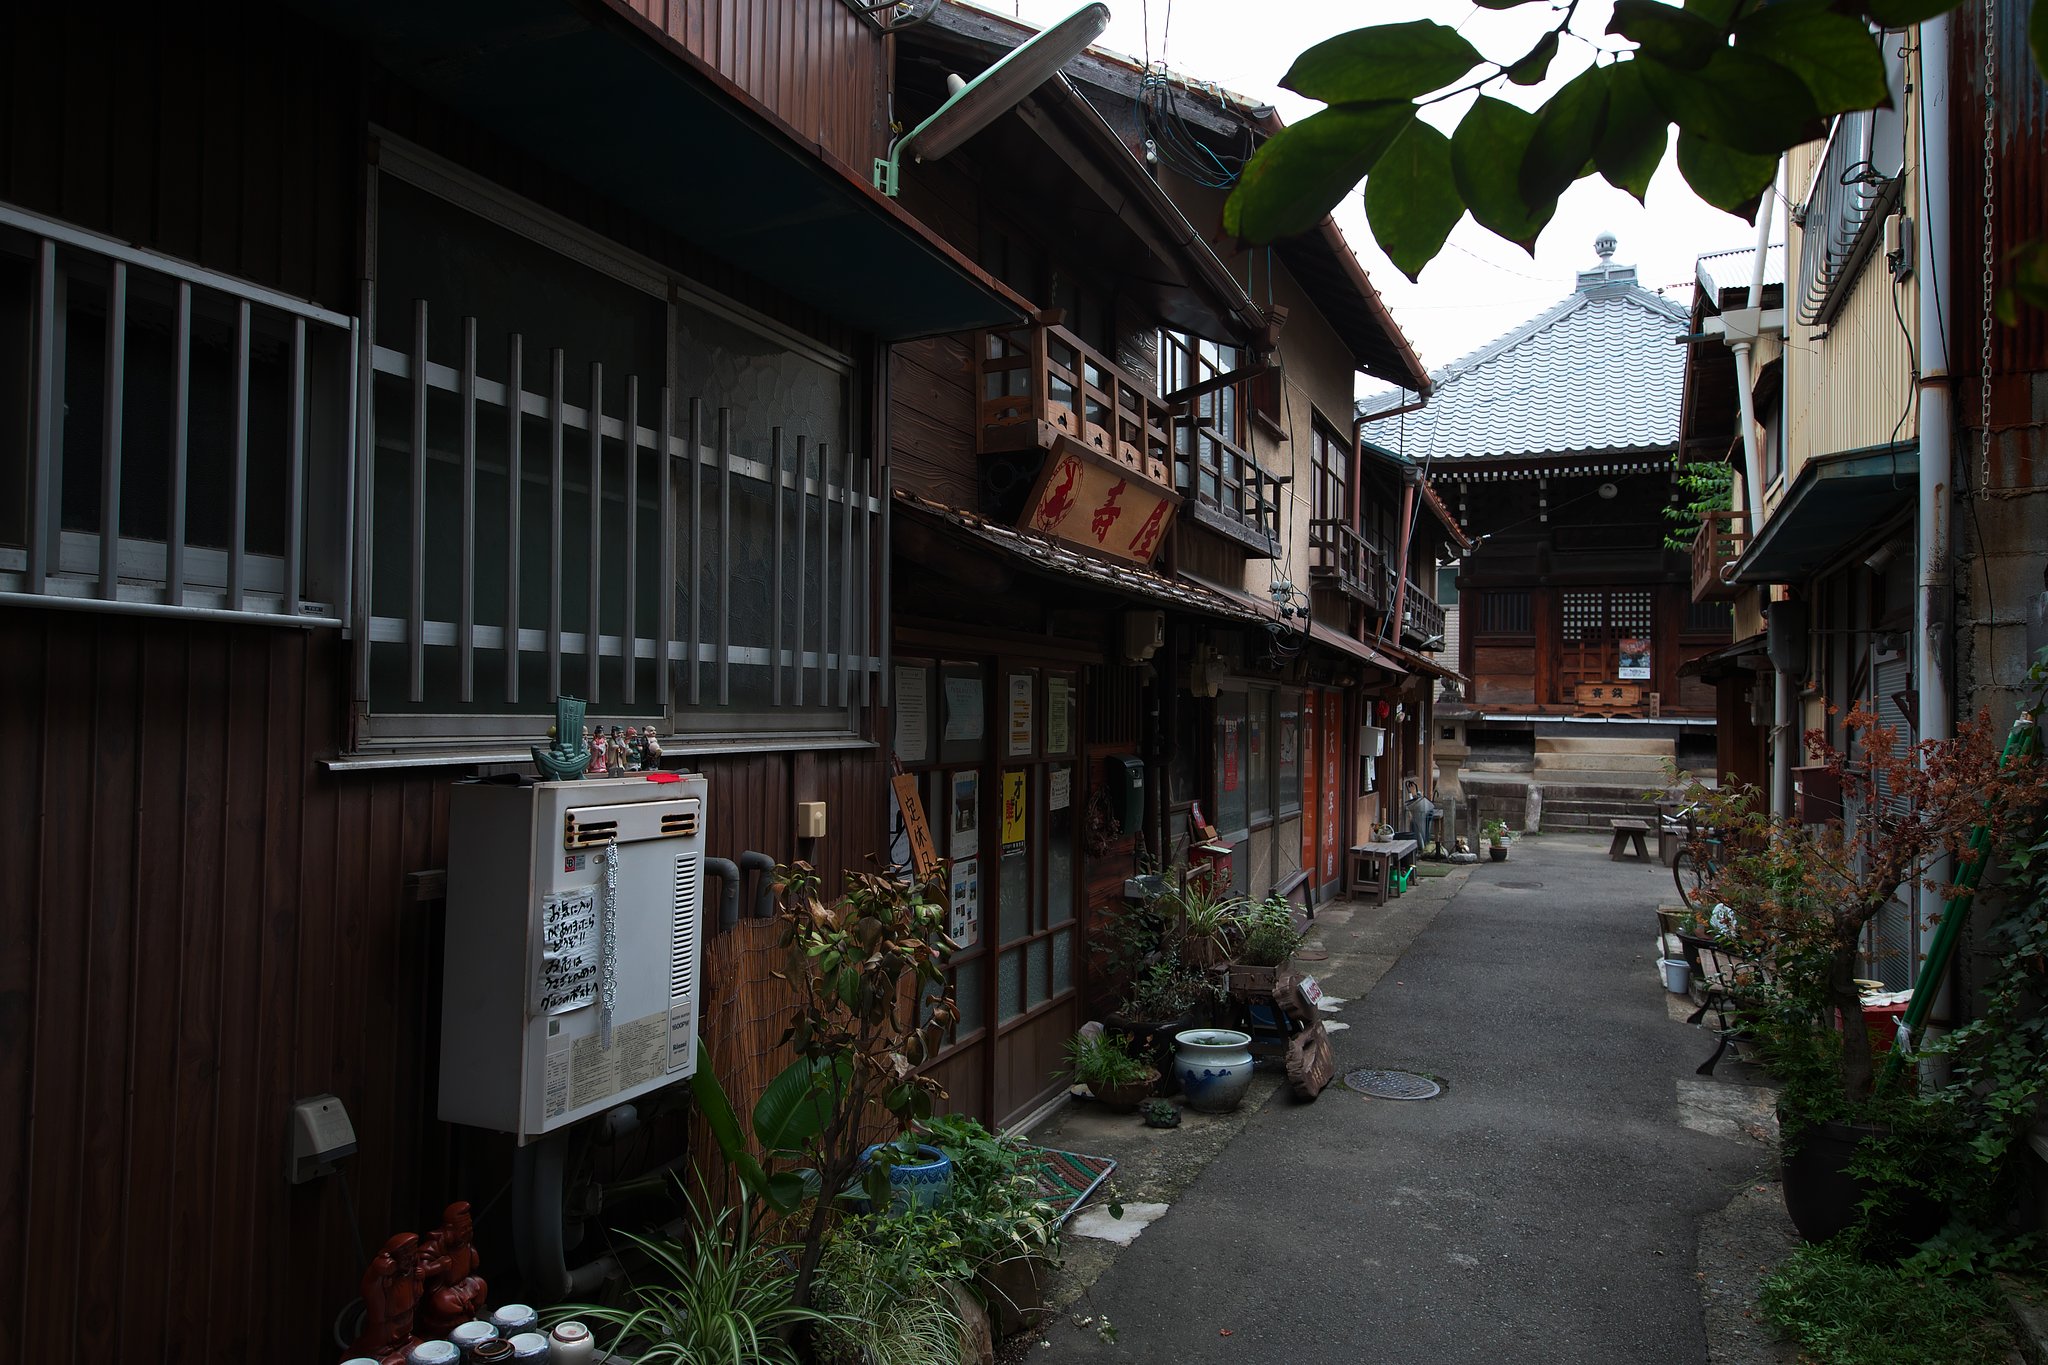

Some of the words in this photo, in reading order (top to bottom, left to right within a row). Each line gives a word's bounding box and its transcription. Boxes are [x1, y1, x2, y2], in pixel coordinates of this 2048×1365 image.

[548, 897, 593, 923] お気に入り
[547, 913, 596, 941] がありましたら
